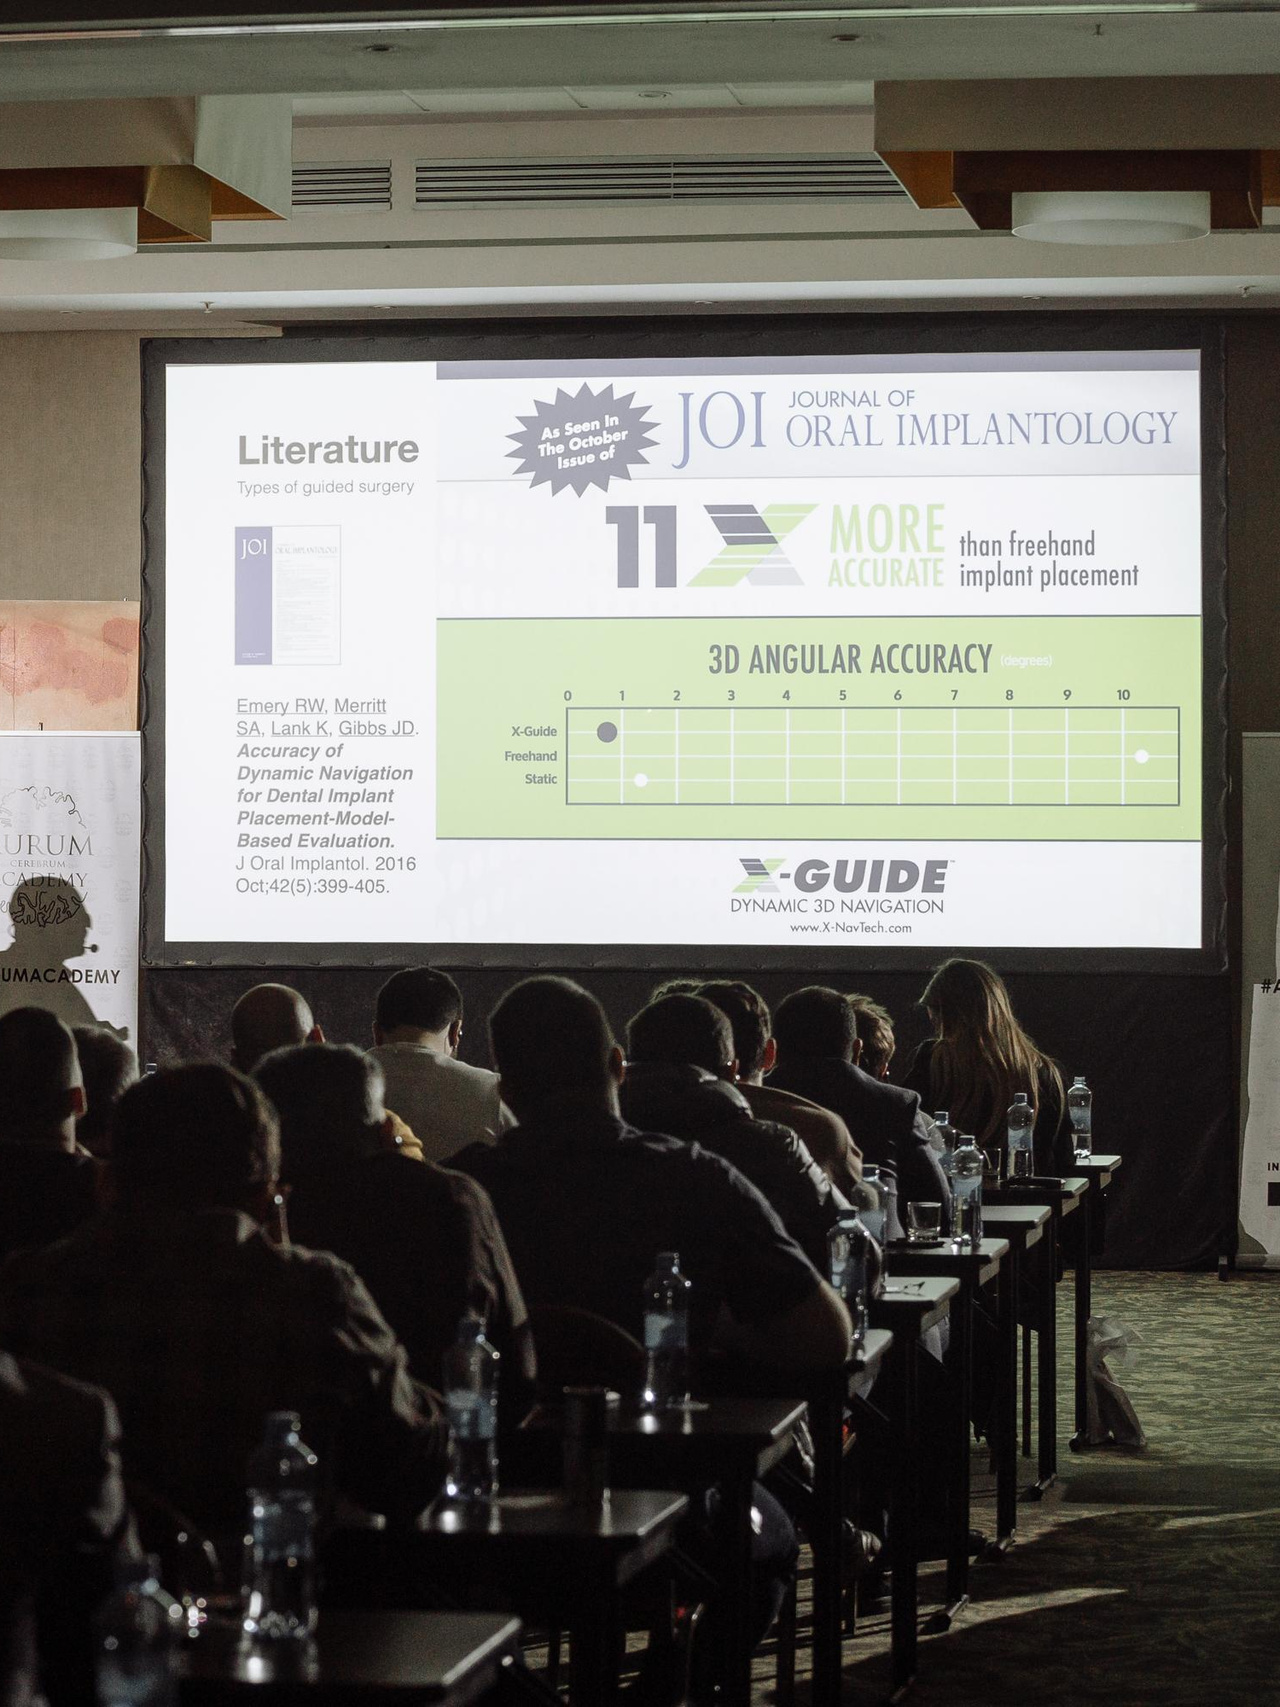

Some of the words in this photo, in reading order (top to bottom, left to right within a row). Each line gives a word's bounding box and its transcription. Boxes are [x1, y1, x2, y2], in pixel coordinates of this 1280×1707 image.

[788, 390, 881, 408] JOURNAL
[888, 390, 915, 407] OF
[541, 427, 560, 440] As
[564, 420, 600, 436] Seen
[604, 414, 619, 428] In
[672, 391, 766, 470] JOI
[786, 414, 884, 448] ORAL
[896, 411, 1178, 446] IMPLANTOLOGY
[239, 436, 419, 464] Literature
[538, 442, 564, 456] The
[569, 430, 628, 450] October
[558, 454, 595, 470] Issue
[600, 444, 616, 460] of
[237, 480, 280, 497] Types
[284, 480, 298, 494] of
[303, 480, 354, 496] guided
[359, 482, 414, 496] surgery
[830, 503, 945, 554] MORE
[240, 538, 267, 560] JOI
[960, 530, 1002, 556] than
[1009, 530, 1095, 556] freehand
[828, 557, 944, 587] ACCURATE
[960, 560, 1033, 592] implant
[1040, 560, 1139, 592] placement
[709, 644, 740, 674] 3D
[749, 644, 862, 674] ANGULAR
[870, 644, 992, 674] ACCURACY
[1000, 654, 1052, 668] (degrees)
[564, 690, 572, 701] 0
[619, 690, 624, 701] 1
[673, 690, 680, 701] 2
[728, 690, 735, 701] 3
[782, 690, 790, 701] 4
[839, 690, 846, 701] 5
[894, 690, 902, 701] 6
[951, 690, 958, 701] 7
[1006, 690, 1014, 701] 8
[1064, 690, 1071, 701] 9
[1117, 690, 1130, 701] 10
[237, 698, 289, 716] Emery
[296, 698, 328, 714] RW,
[334, 698, 386, 713] Merritt
[236, 721, 265, 737] SA,
[271, 721, 310, 736] Lank
[317, 721, 332, 737] K,
[339, 720, 386, 736] Gibbs
[392, 721, 419, 736] JD.
[512, 726, 557, 737] X-Guide
[237, 744, 320, 761] Accuracy
[325, 743, 344, 758] of
[505, 751, 557, 762] Freehand
[237, 766, 314, 783] Dynamic
[319, 766, 413, 783] Navigation
[525, 774, 557, 784] Static
[237, 788, 262, 802] for
[267, 788, 323, 802] Dental
[328, 788, 394, 806] Implant
[237, 811, 394, 825] Placement-Model-
[237, 834, 292, 848] Based
[298, 834, 395, 848] Evaluation.
[10, 860, 66, 868] CEREBRUM
[236, 856, 244, 870] J
[250, 856, 284, 870] Oral
[291, 856, 369, 874] Implantol.
[376, 857, 416, 870] 2016
[236, 878, 390, 896] Oct;42(5):399-405.
[731, 898, 808, 912] DYNAMIC
[814, 899, 834, 913] 3D
[841, 900, 944, 913] NAVIGATION
[790, 921, 912, 933] www.X-NavTech.com
